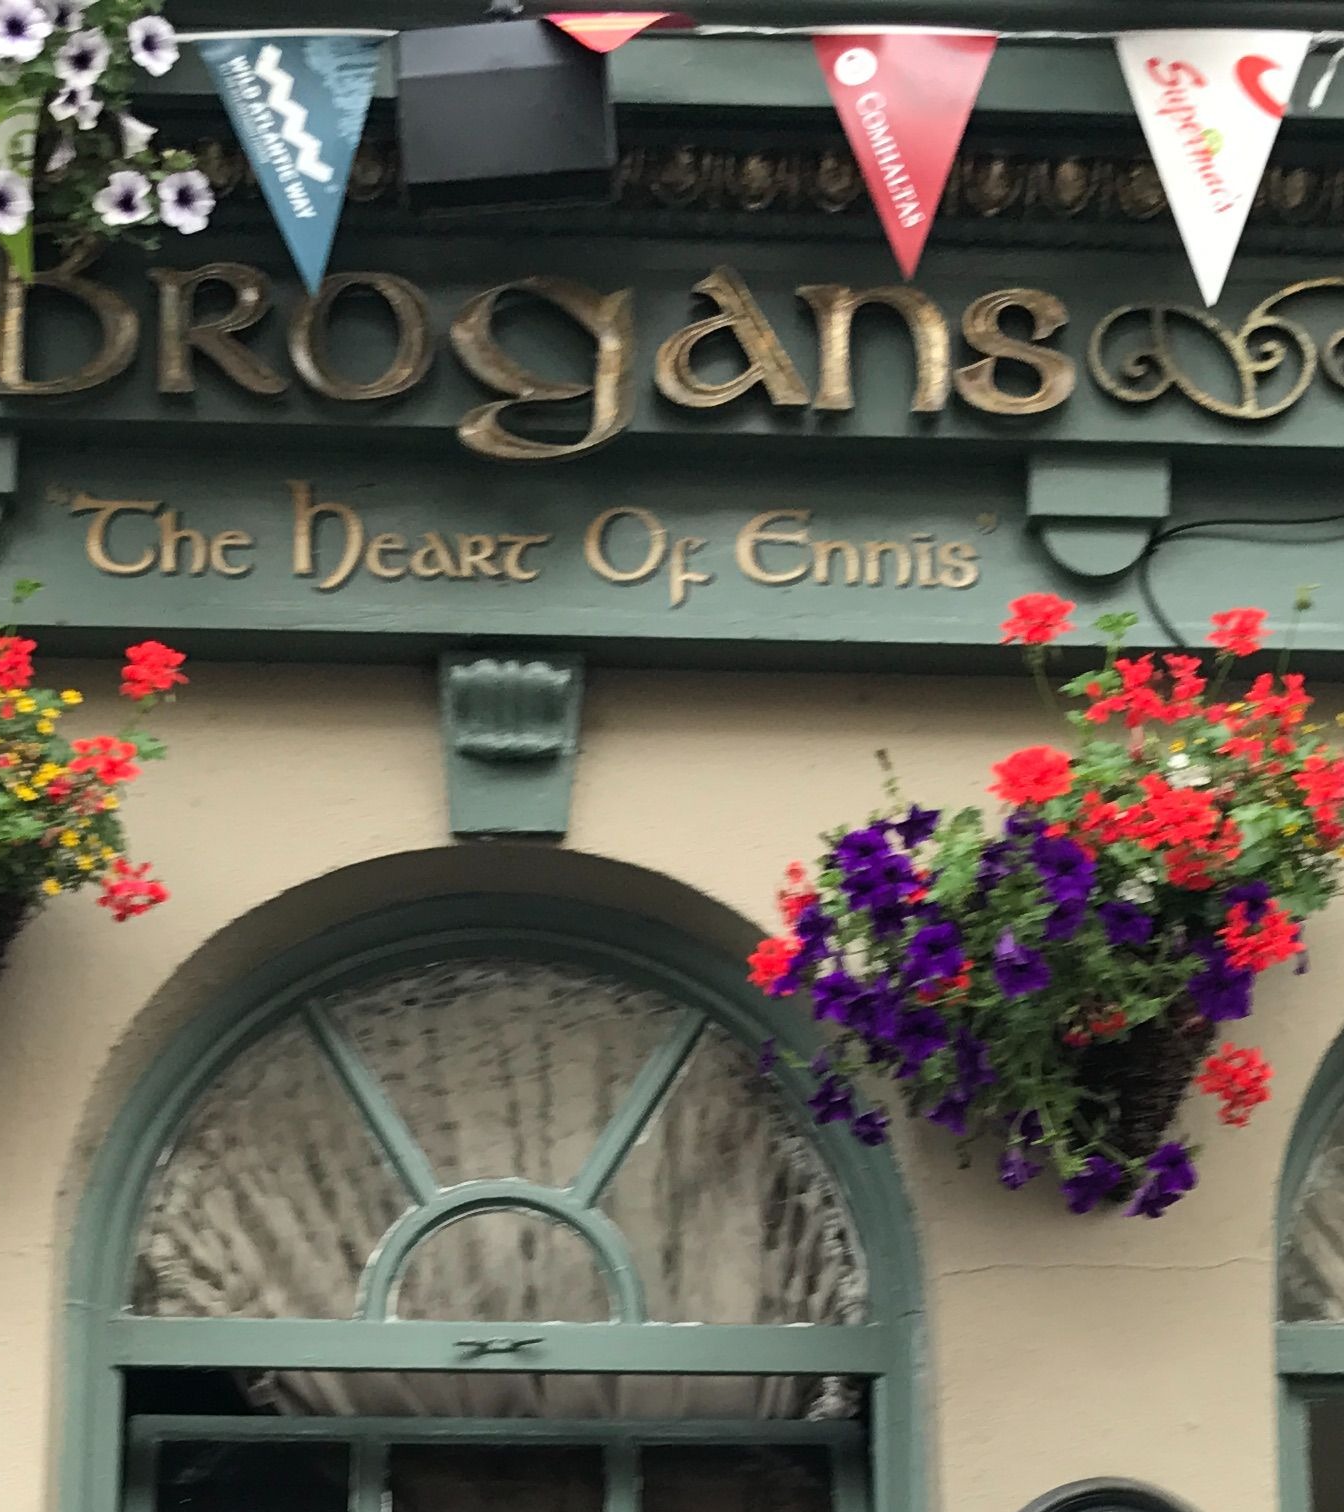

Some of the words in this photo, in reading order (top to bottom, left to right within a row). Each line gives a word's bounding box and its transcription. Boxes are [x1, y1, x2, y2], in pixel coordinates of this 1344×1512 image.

[228, 55, 262, 100] WILD
[249, 101, 302, 184] ATLANTIC
[284, 181, 318, 218] WAY
[285, 480, 554, 593] Heart
[583, 505, 714, 608] Of
